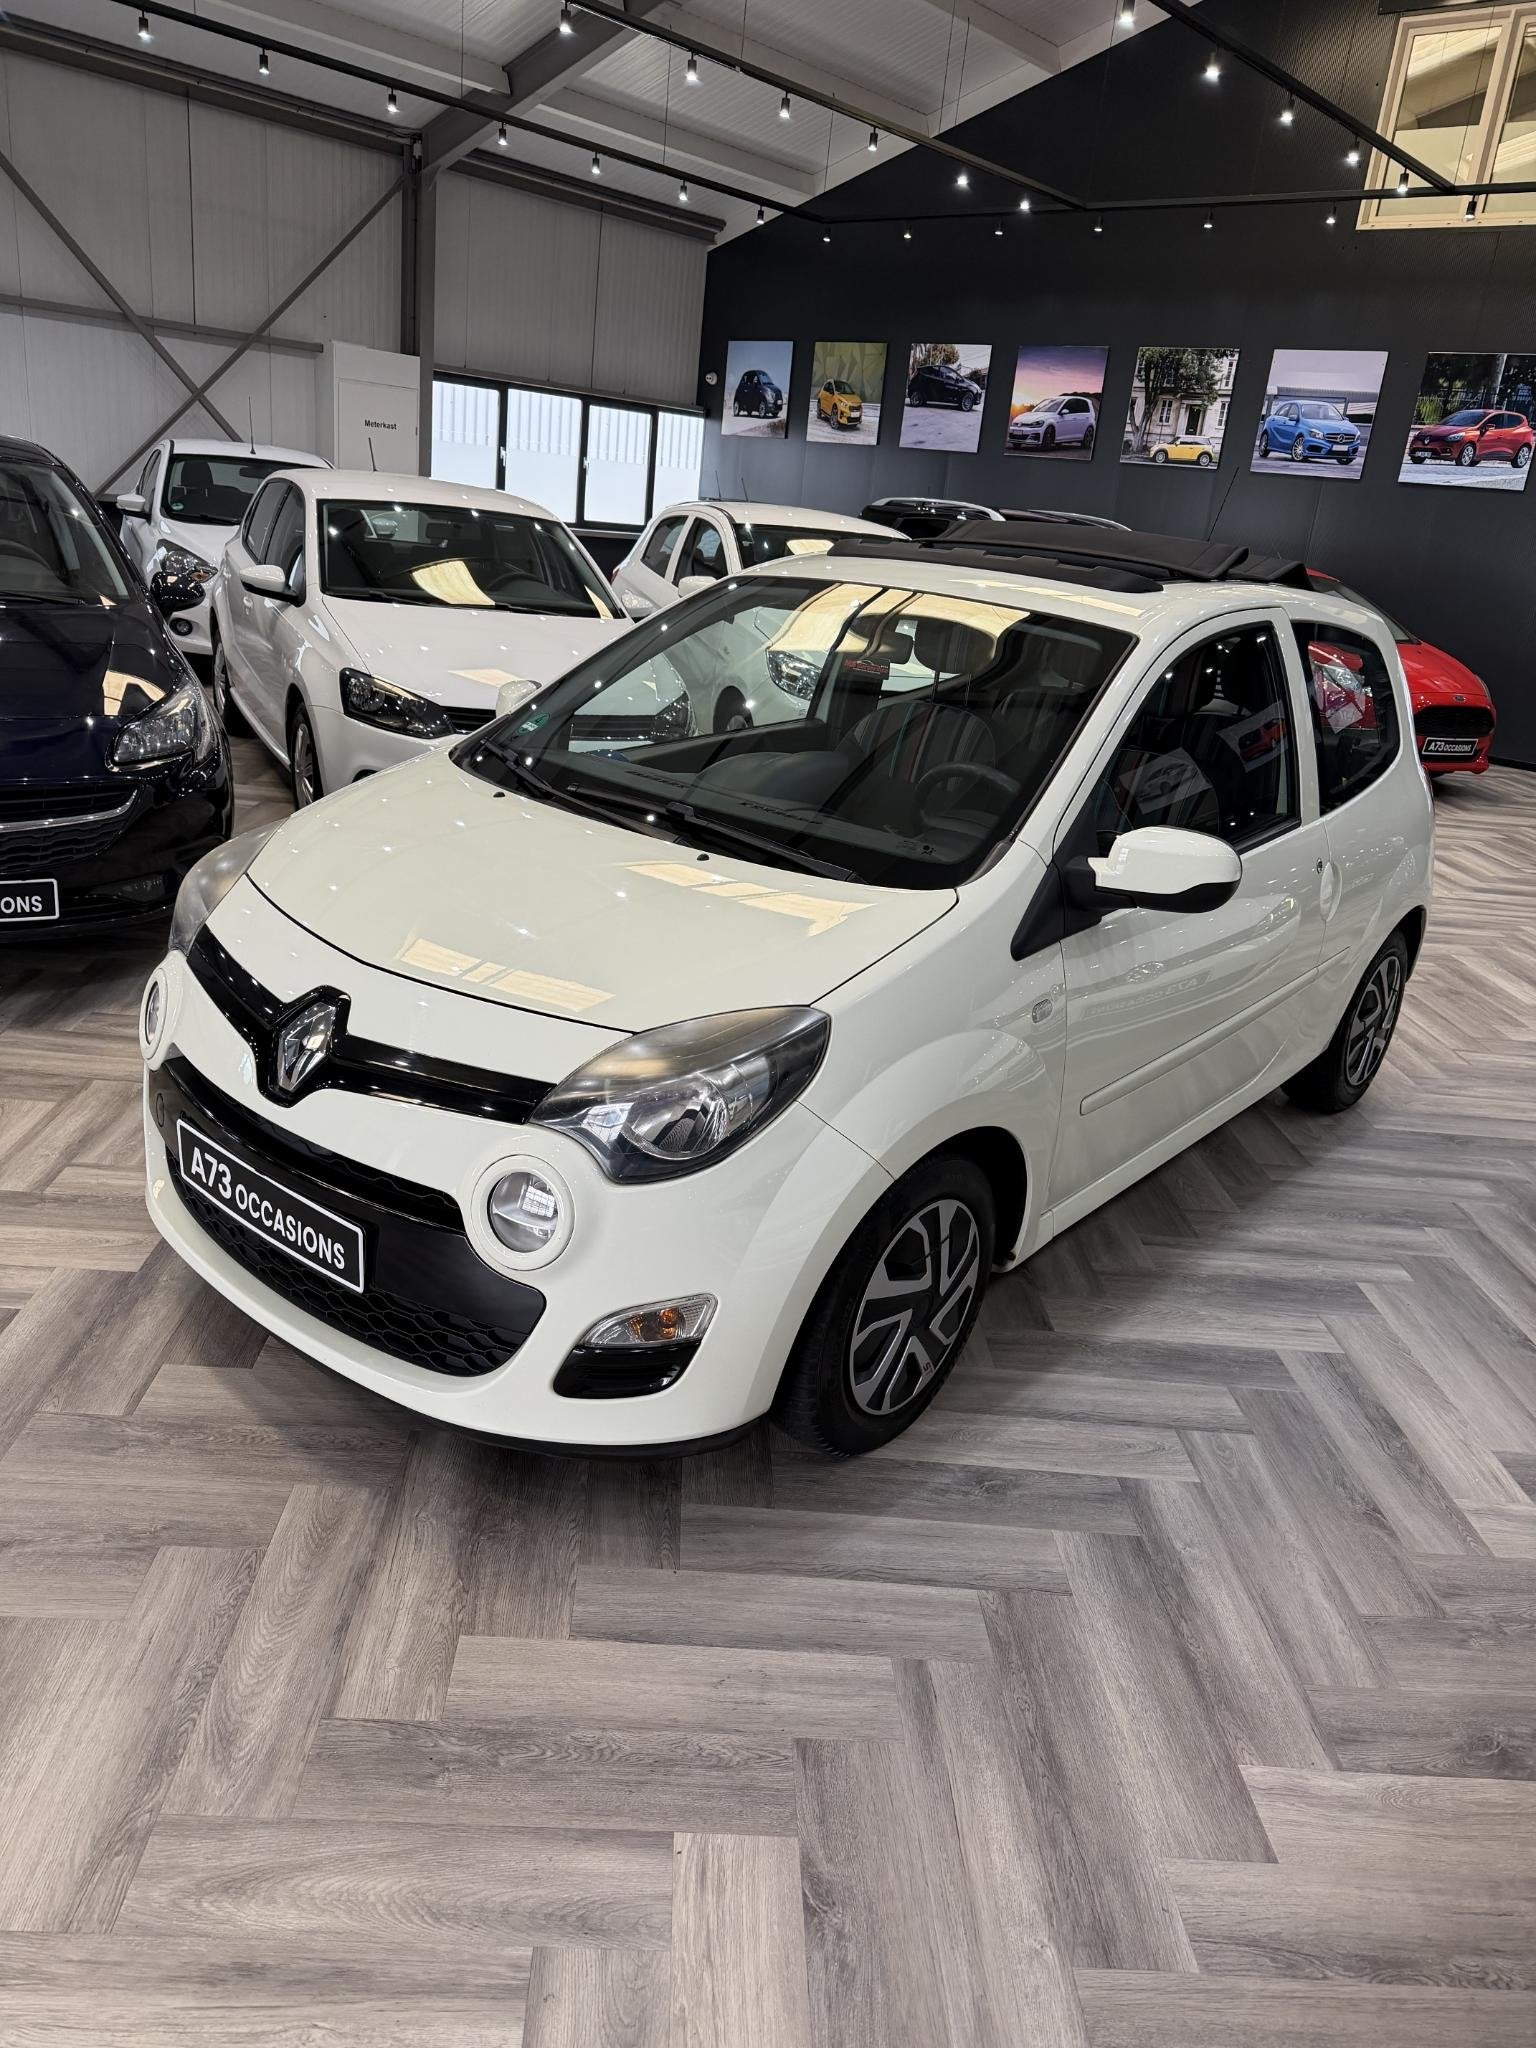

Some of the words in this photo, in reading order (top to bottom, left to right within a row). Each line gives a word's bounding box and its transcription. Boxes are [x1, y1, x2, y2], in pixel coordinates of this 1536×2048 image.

[365, 419, 397, 430] Meterkast
[1428, 742, 1445, 751] A73
[191, 1147, 231, 1199] A73
[235, 1184, 345, 1269] OCCASIONS
